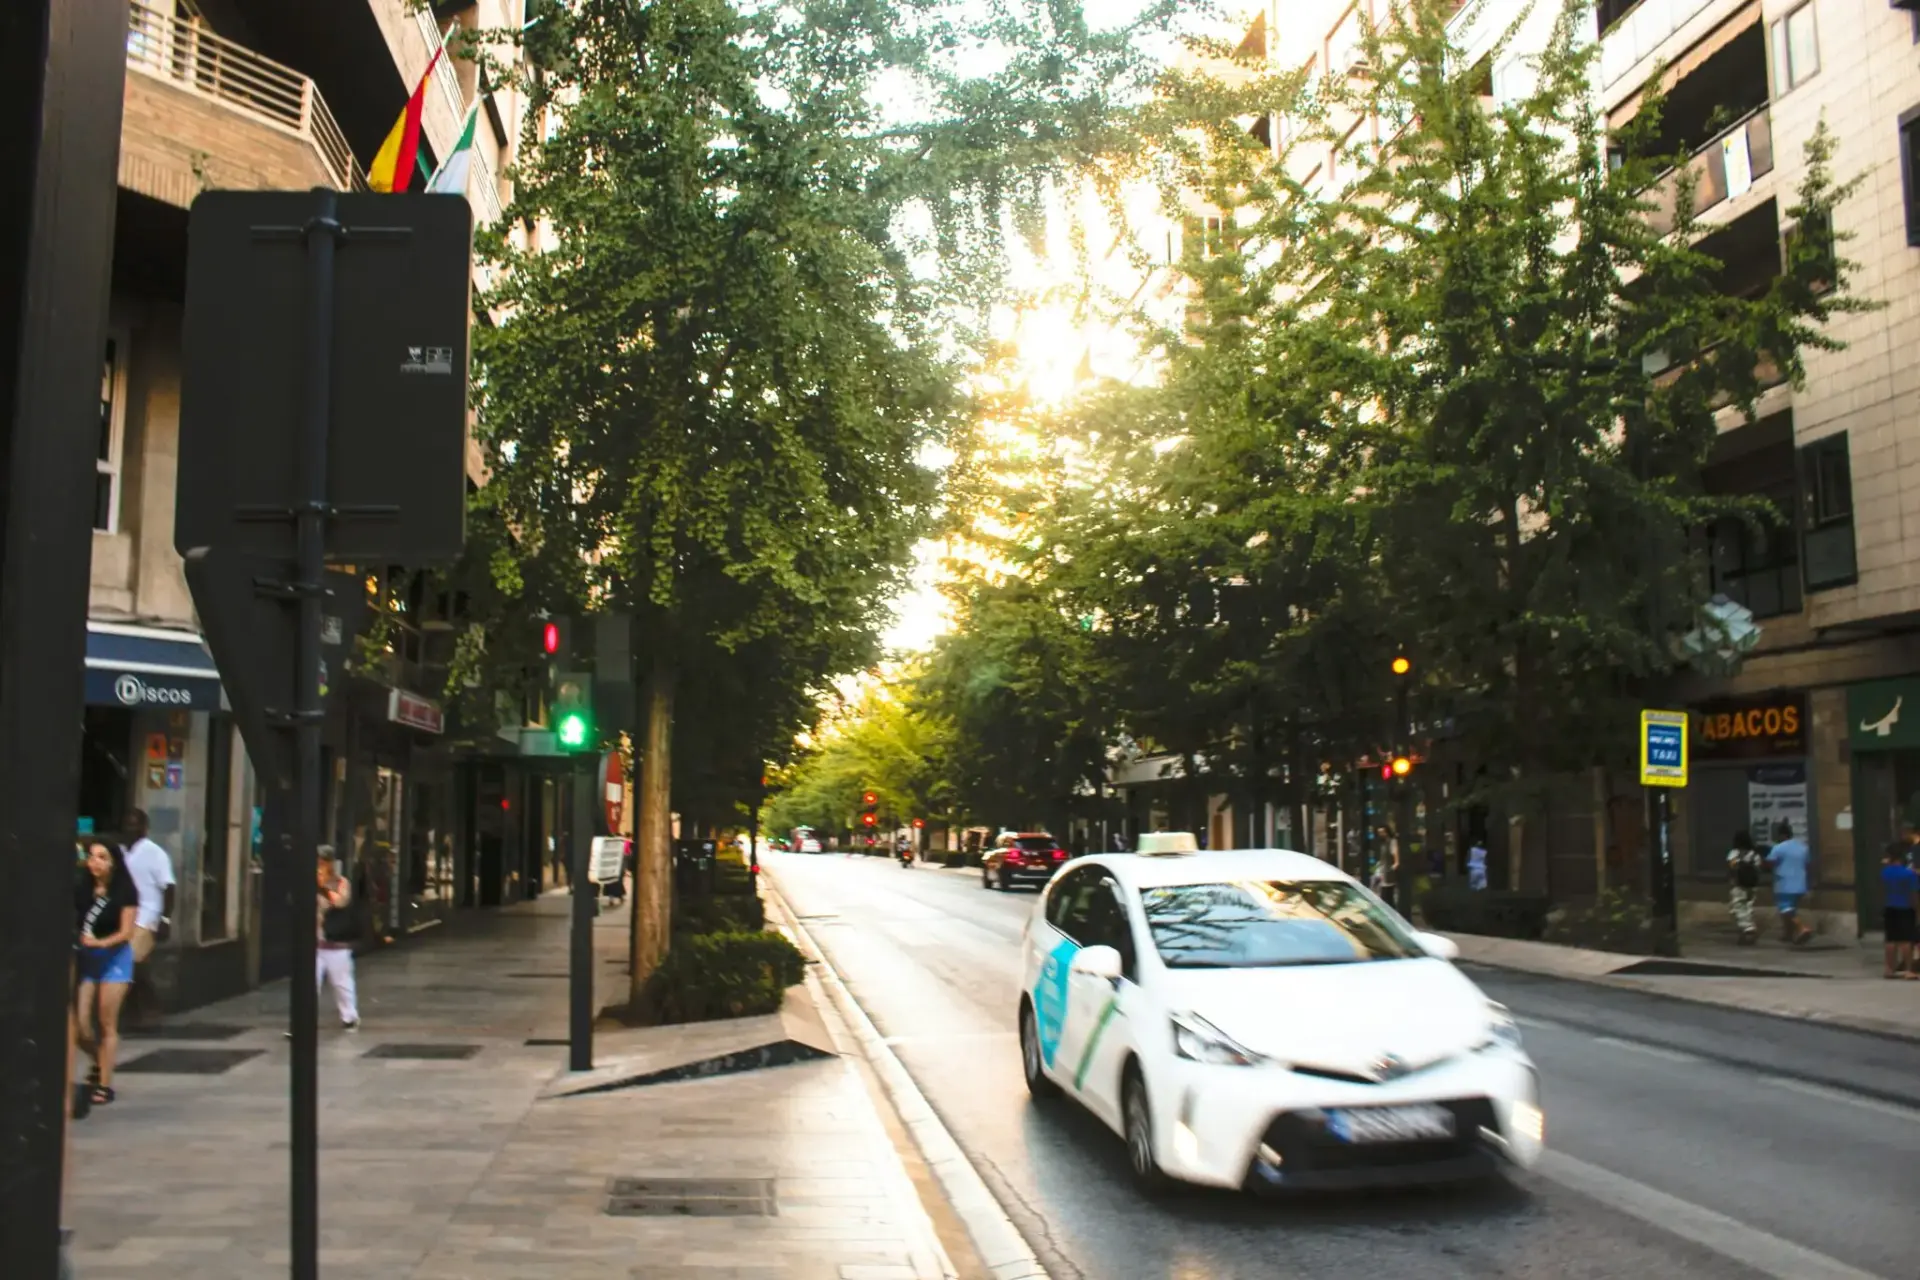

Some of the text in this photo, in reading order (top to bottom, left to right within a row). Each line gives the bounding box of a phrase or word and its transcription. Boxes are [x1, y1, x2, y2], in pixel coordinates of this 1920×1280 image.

[115, 674, 192, 705] Discos
[1697, 705, 1798, 740] ABACOS
[1652, 748, 1678, 761] TAXI
